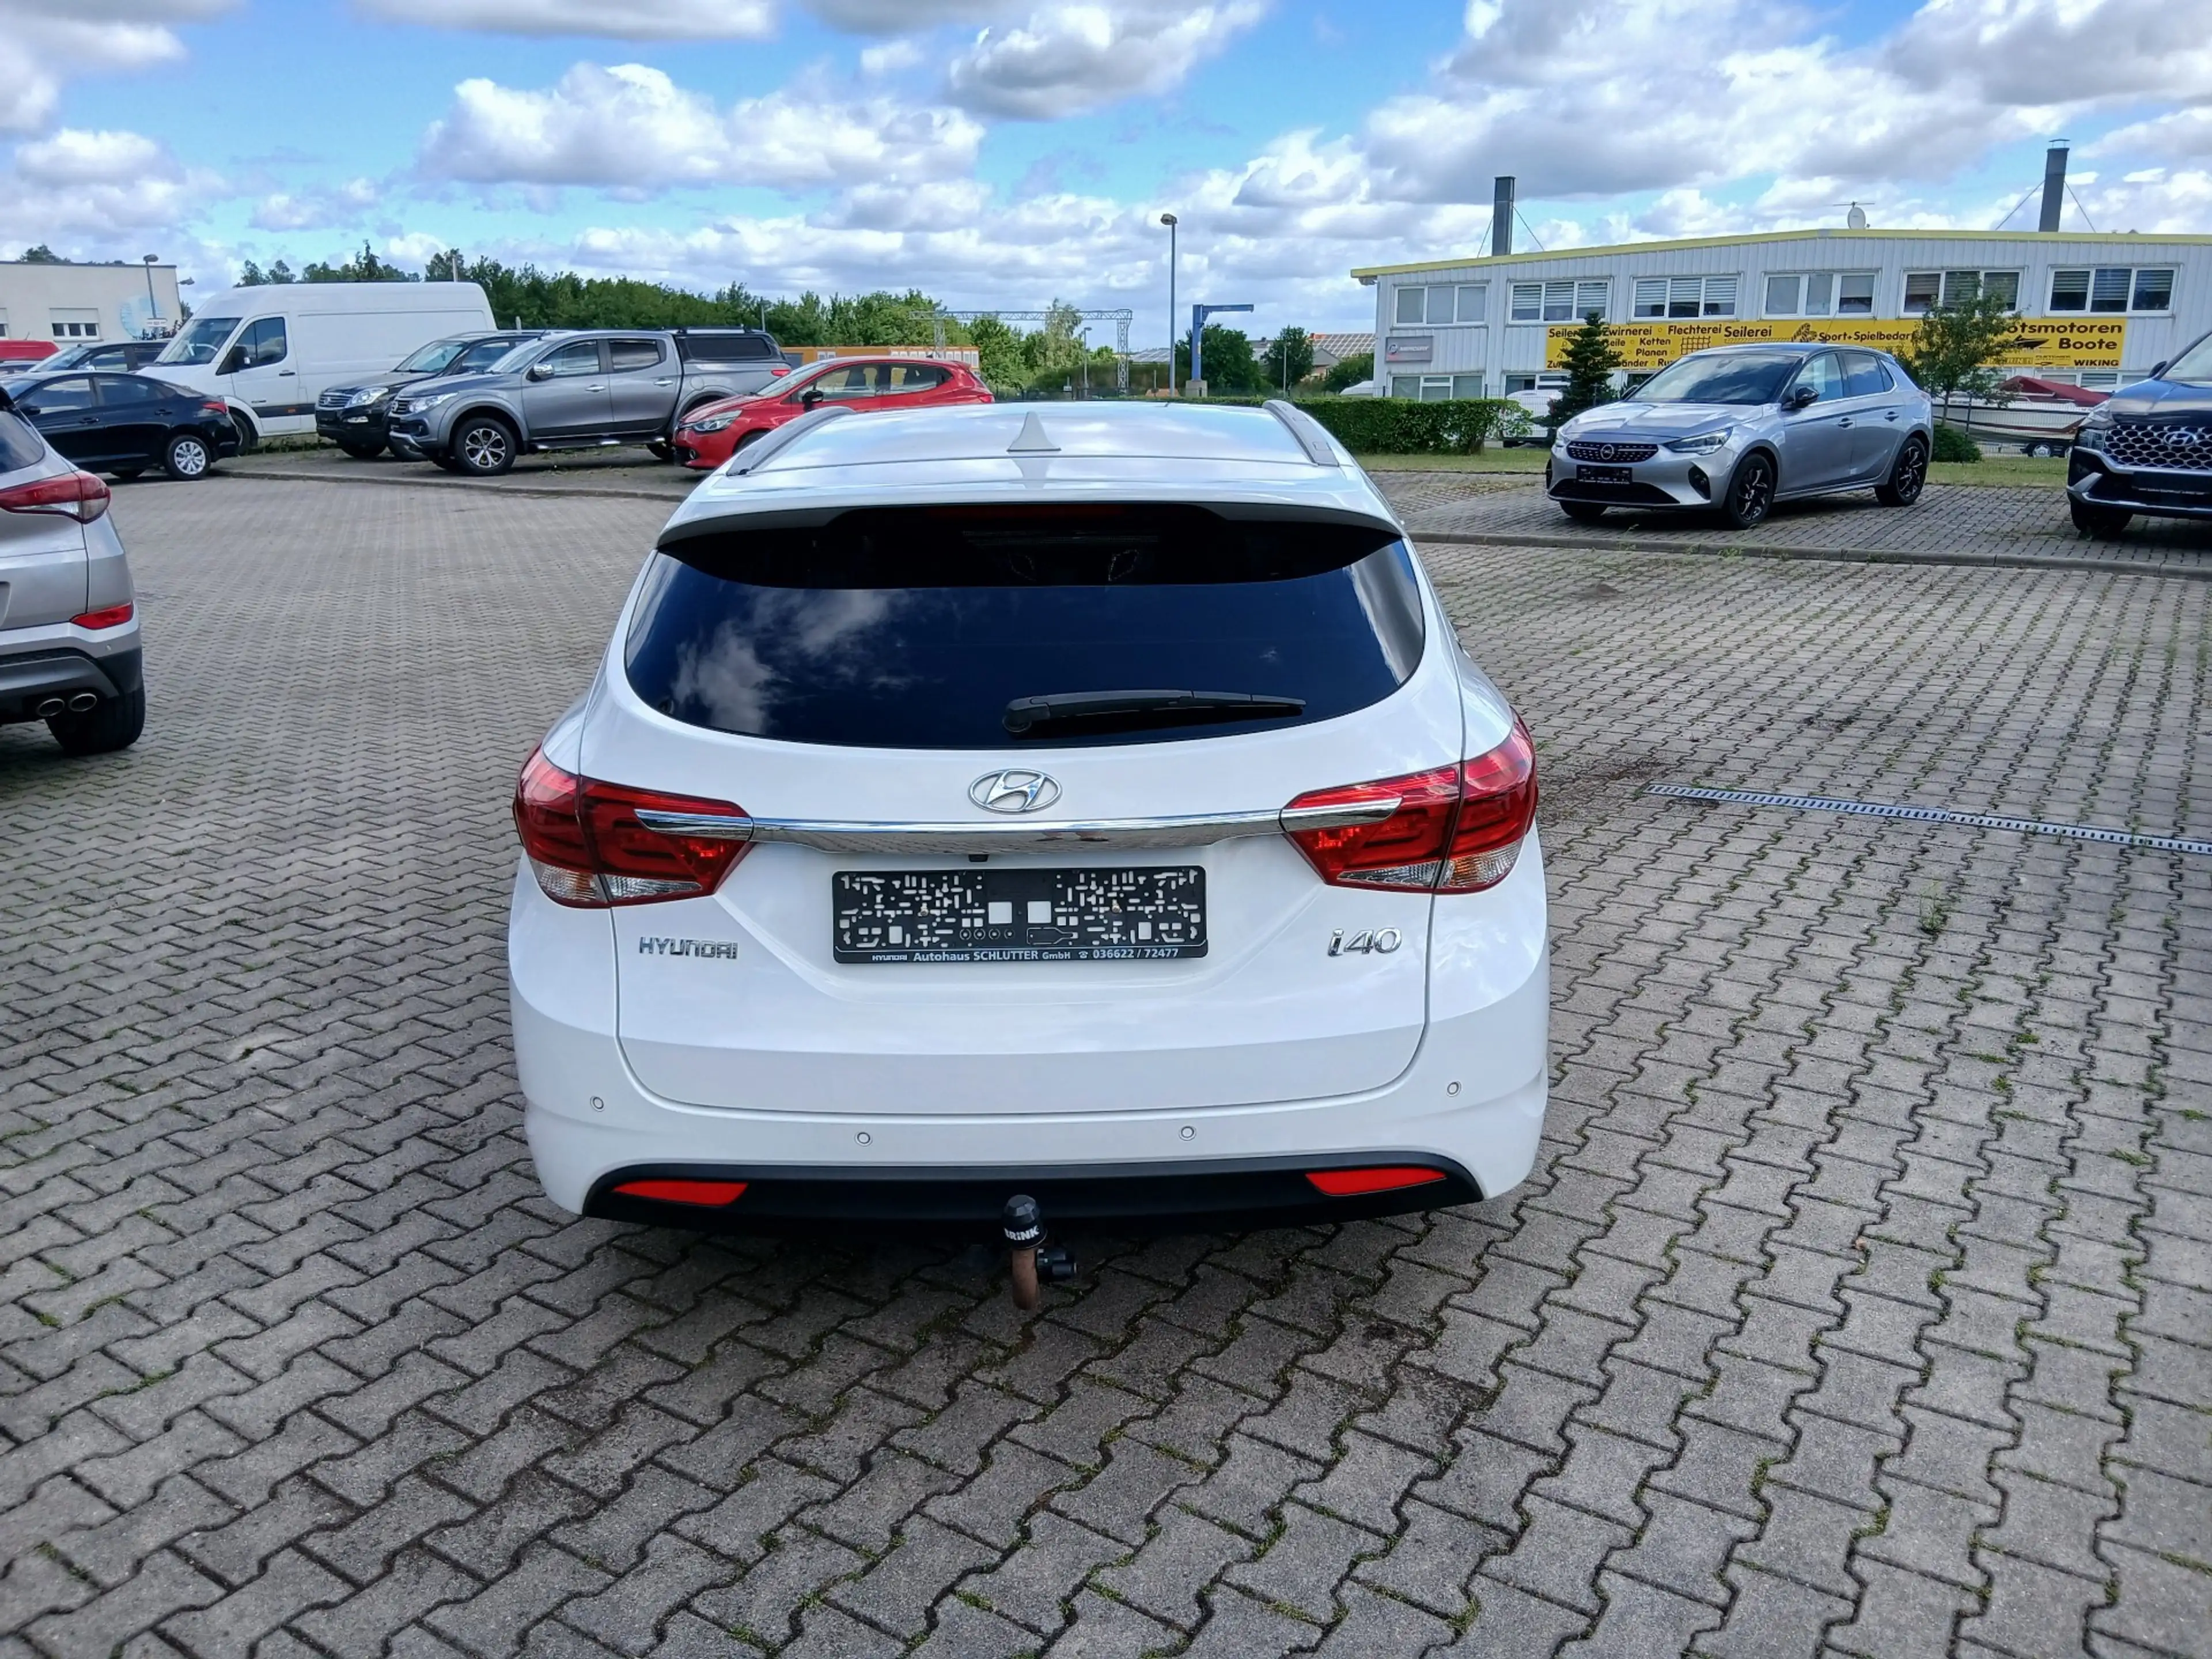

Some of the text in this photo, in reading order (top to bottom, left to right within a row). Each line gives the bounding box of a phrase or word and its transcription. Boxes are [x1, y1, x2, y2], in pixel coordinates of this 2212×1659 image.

[1602, 326, 1652, 336] Zwirnerei
[1668, 324, 1722, 335] Flechterei
[1724, 325, 1772, 337] Seilerei
[2006, 322, 2122, 334] otsmotoren
[1639, 337, 1671, 346] Ketten
[2059, 338, 2117, 350] Boote
[1635, 347, 1667, 357] Planen
[639, 937, 737, 959] HYUNDAI
[1328, 927, 1402, 957] i40
[913, 952, 970, 961] Autohaus
[974, 950, 1039, 960] SCHLUTTER
[1093, 949, 1134, 959] 036622
[1144, 948, 1179, 957] 72477
